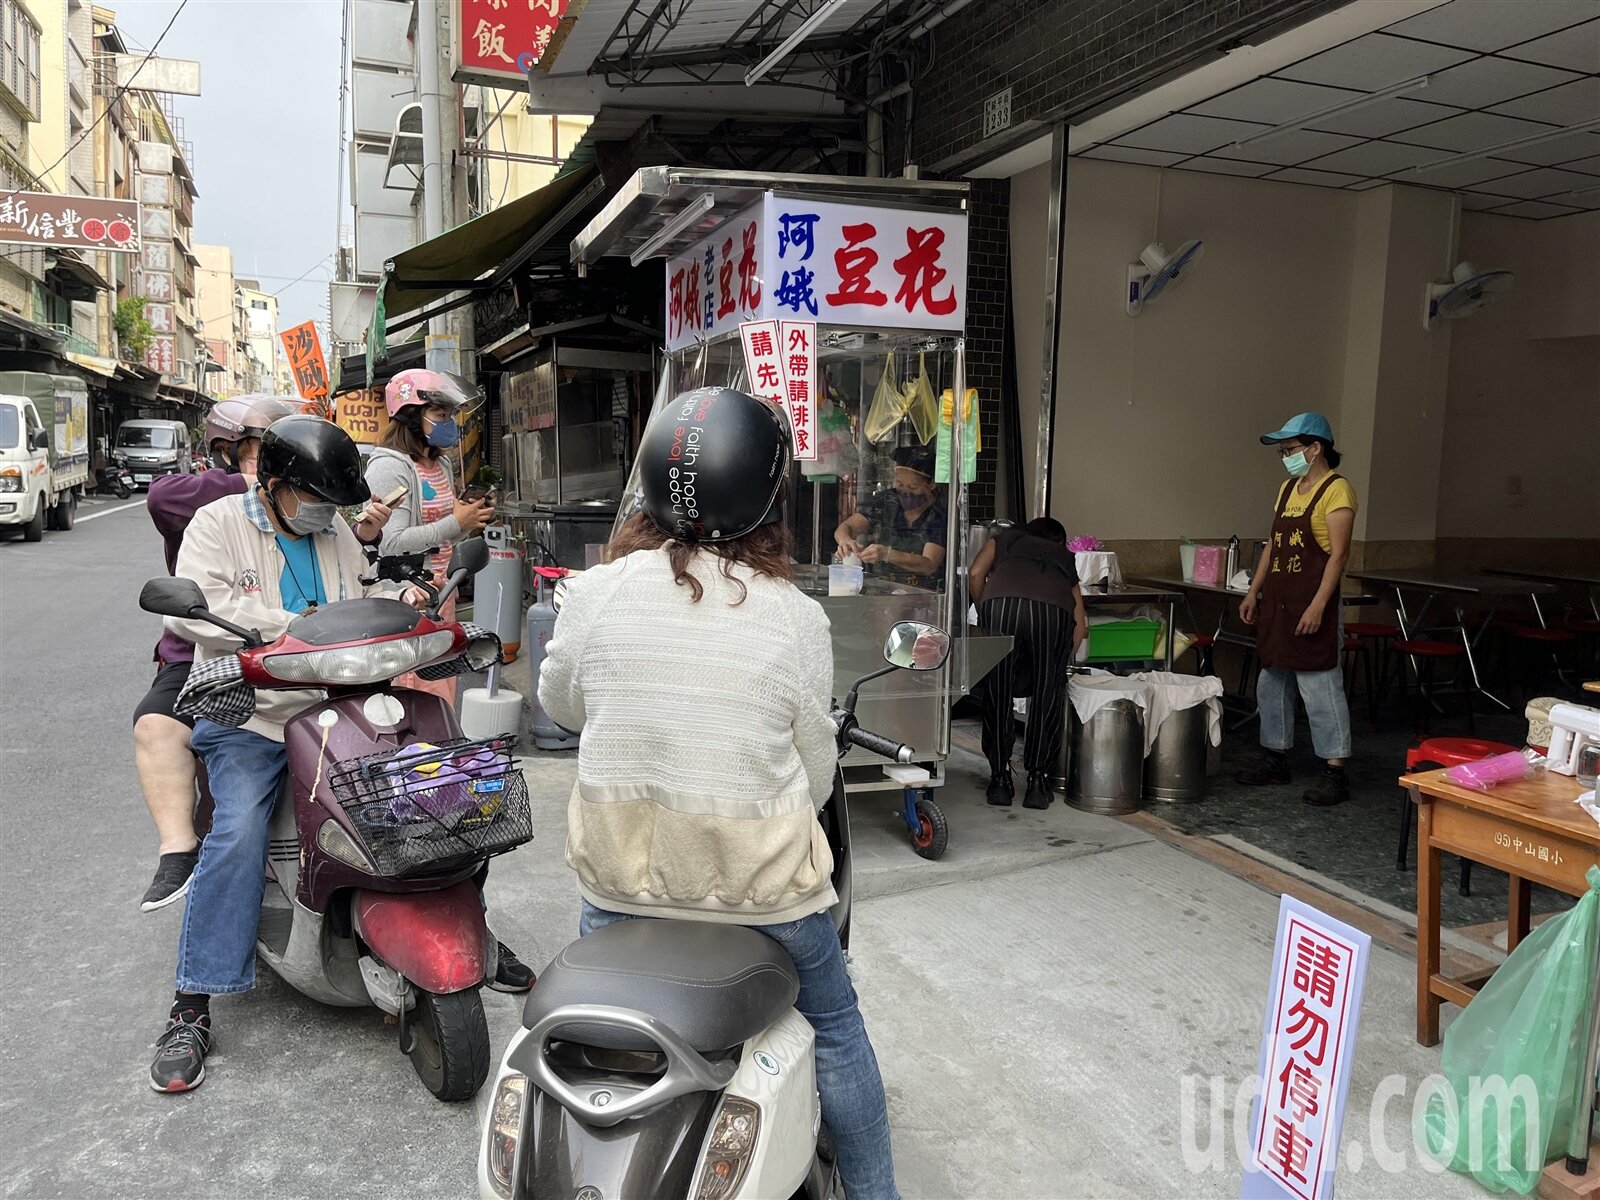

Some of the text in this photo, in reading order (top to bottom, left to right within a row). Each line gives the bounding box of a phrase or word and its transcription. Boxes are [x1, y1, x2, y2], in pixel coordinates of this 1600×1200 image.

[472, 0, 515, 63] 飯
[991, 107, 1008, 130] 233
[0, 196, 81, 239] 新信豐
[669, 221, 762, 341] 阿娥 老店 豆花
[774, 213, 957, 316] 阿娥 豆花
[343, 404, 385, 418] war
[349, 420, 379, 433] ma
[667, 426, 686, 461] love
[684, 426, 704, 465] faith
[683, 472, 699, 518] hope
[1271, 554, 1302, 573] 豆花
[1267, 935, 1341, 1184] 請勿停車
